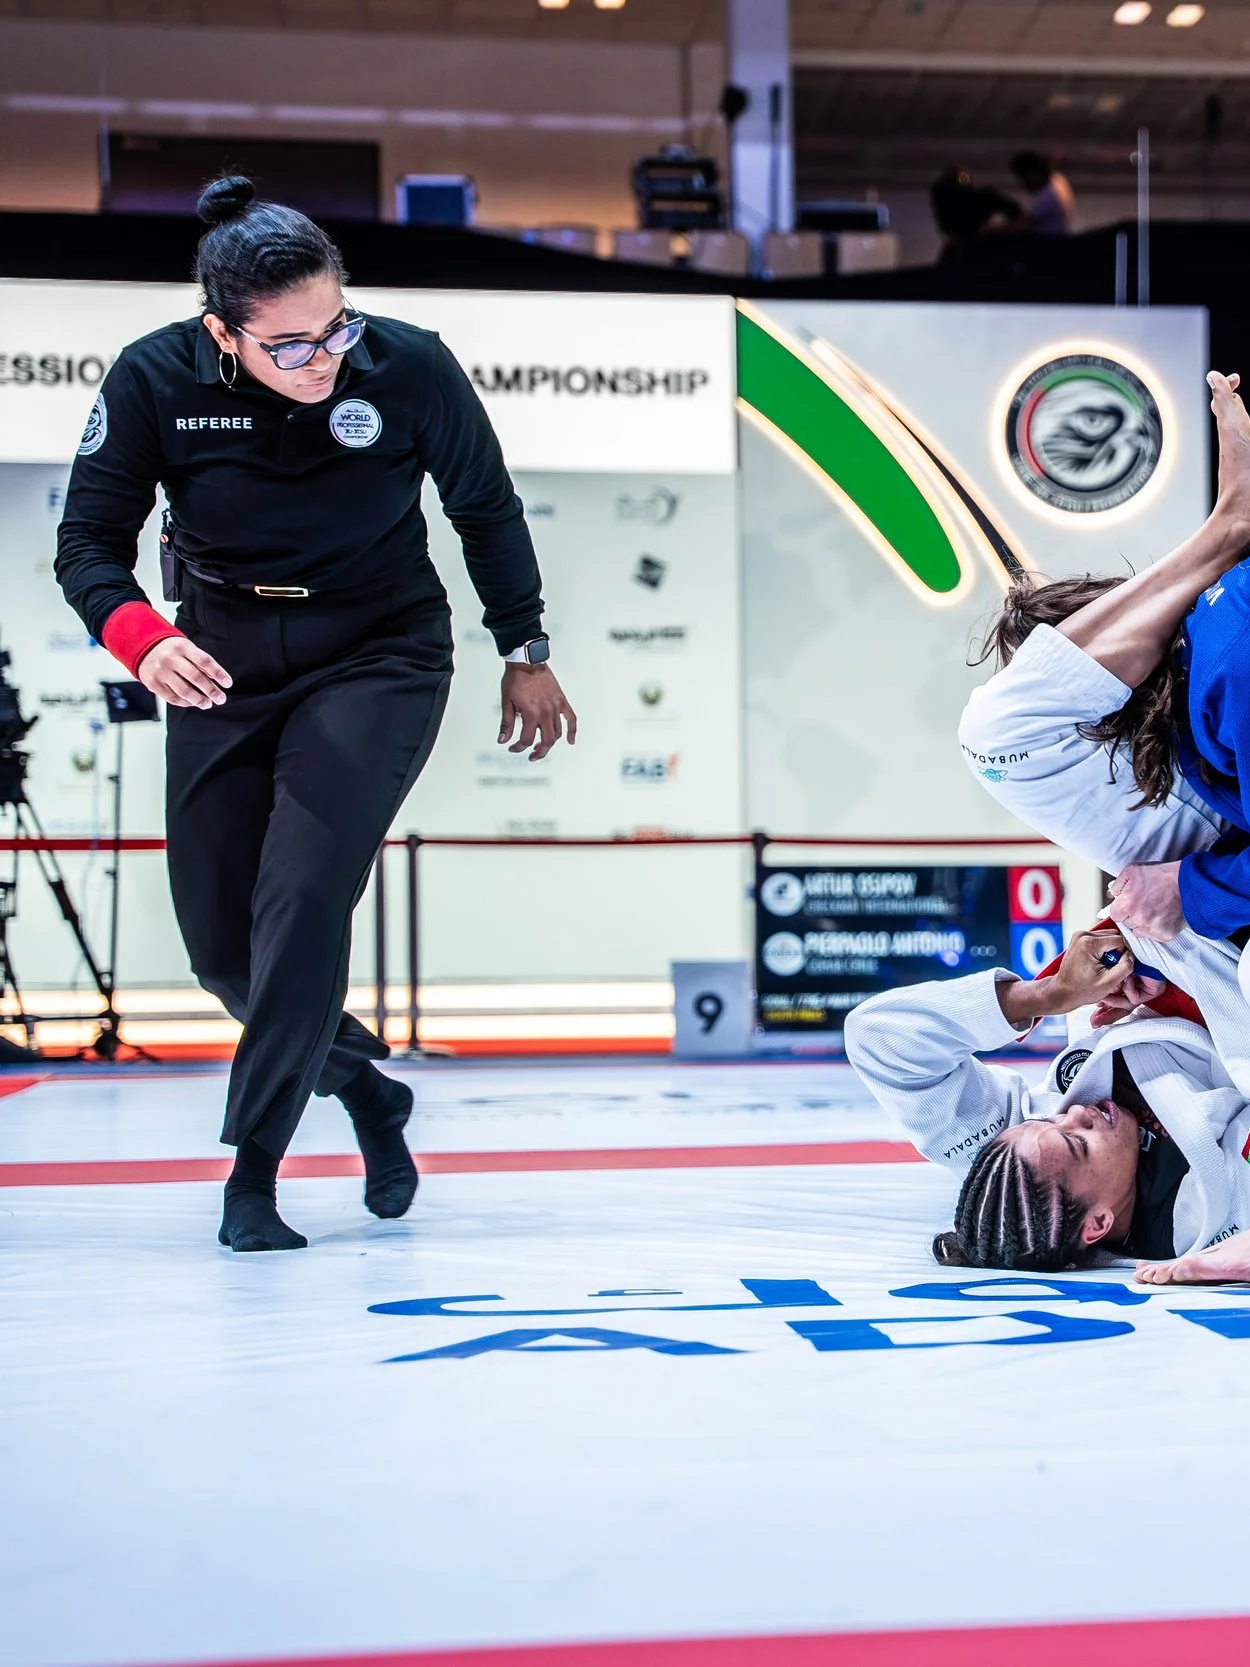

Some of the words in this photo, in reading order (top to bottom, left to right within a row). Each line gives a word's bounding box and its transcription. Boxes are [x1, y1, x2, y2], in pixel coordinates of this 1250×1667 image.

[0, 354, 116, 385] ESSIO
[176, 417, 253, 430] REFEREE
[340, 413, 371, 422] WORLD
[961, 743, 1030, 764] MUBADALA
[1018, 868, 1057, 919] 0
[1021, 927, 1058, 979] 0
[694, 991, 724, 1035] 9
[943, 1116, 1005, 1160] MUBADALA
